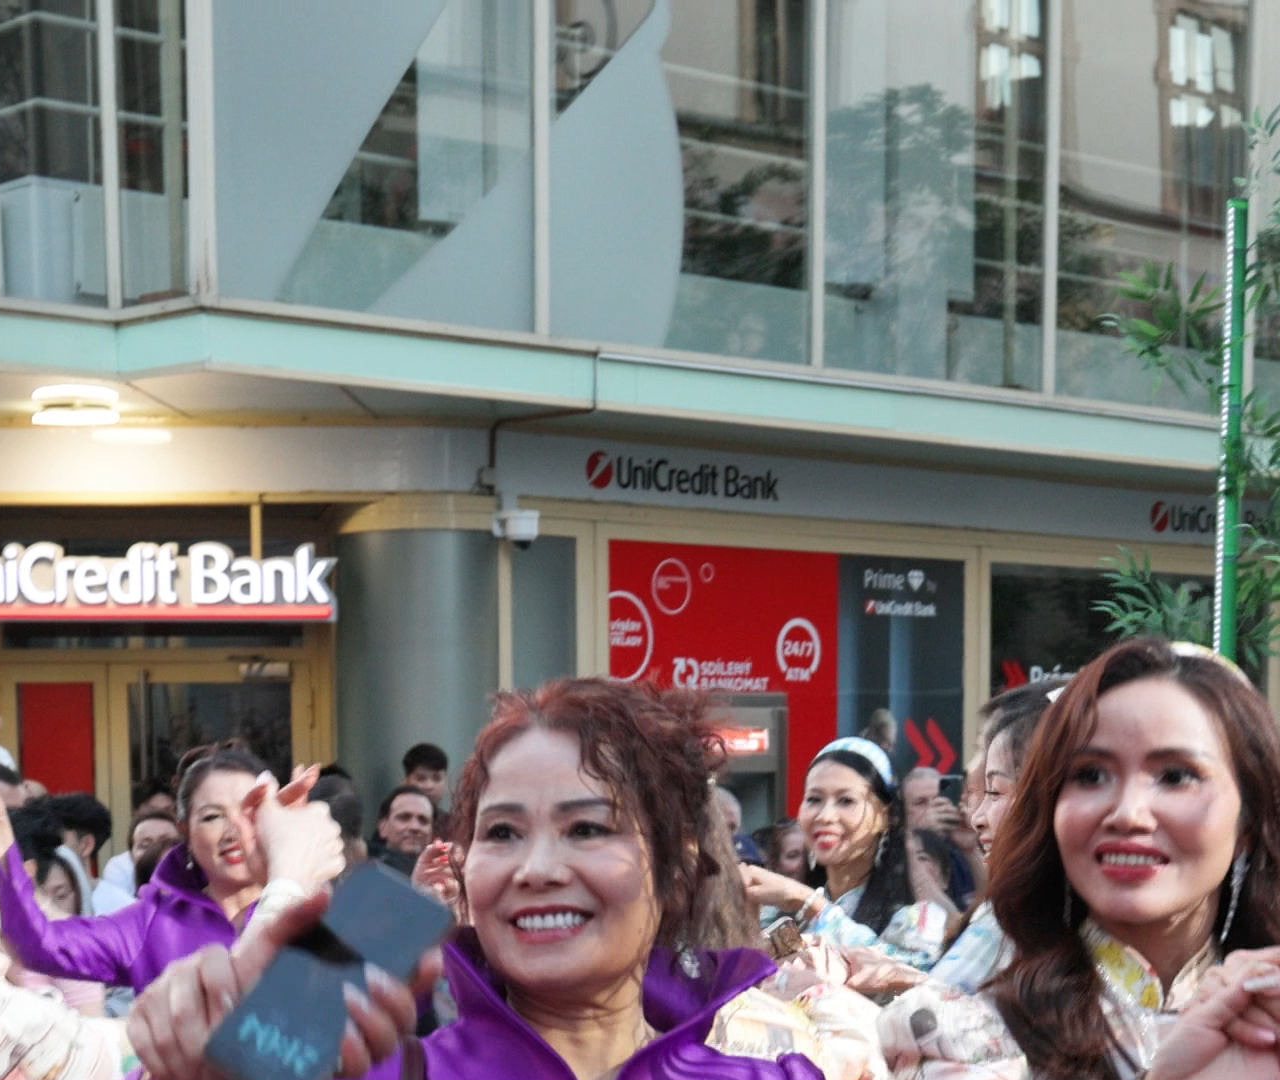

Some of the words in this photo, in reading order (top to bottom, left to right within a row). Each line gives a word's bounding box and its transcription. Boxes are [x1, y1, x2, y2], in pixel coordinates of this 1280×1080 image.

[616, 456, 718, 495] UniCredit
[724, 465, 779, 500] Bank
[189, 541, 333, 606] Bank
[863, 568, 905, 591] Prime
[783, 640, 814, 658] 24/7
[785, 667, 811, 682] ATM
